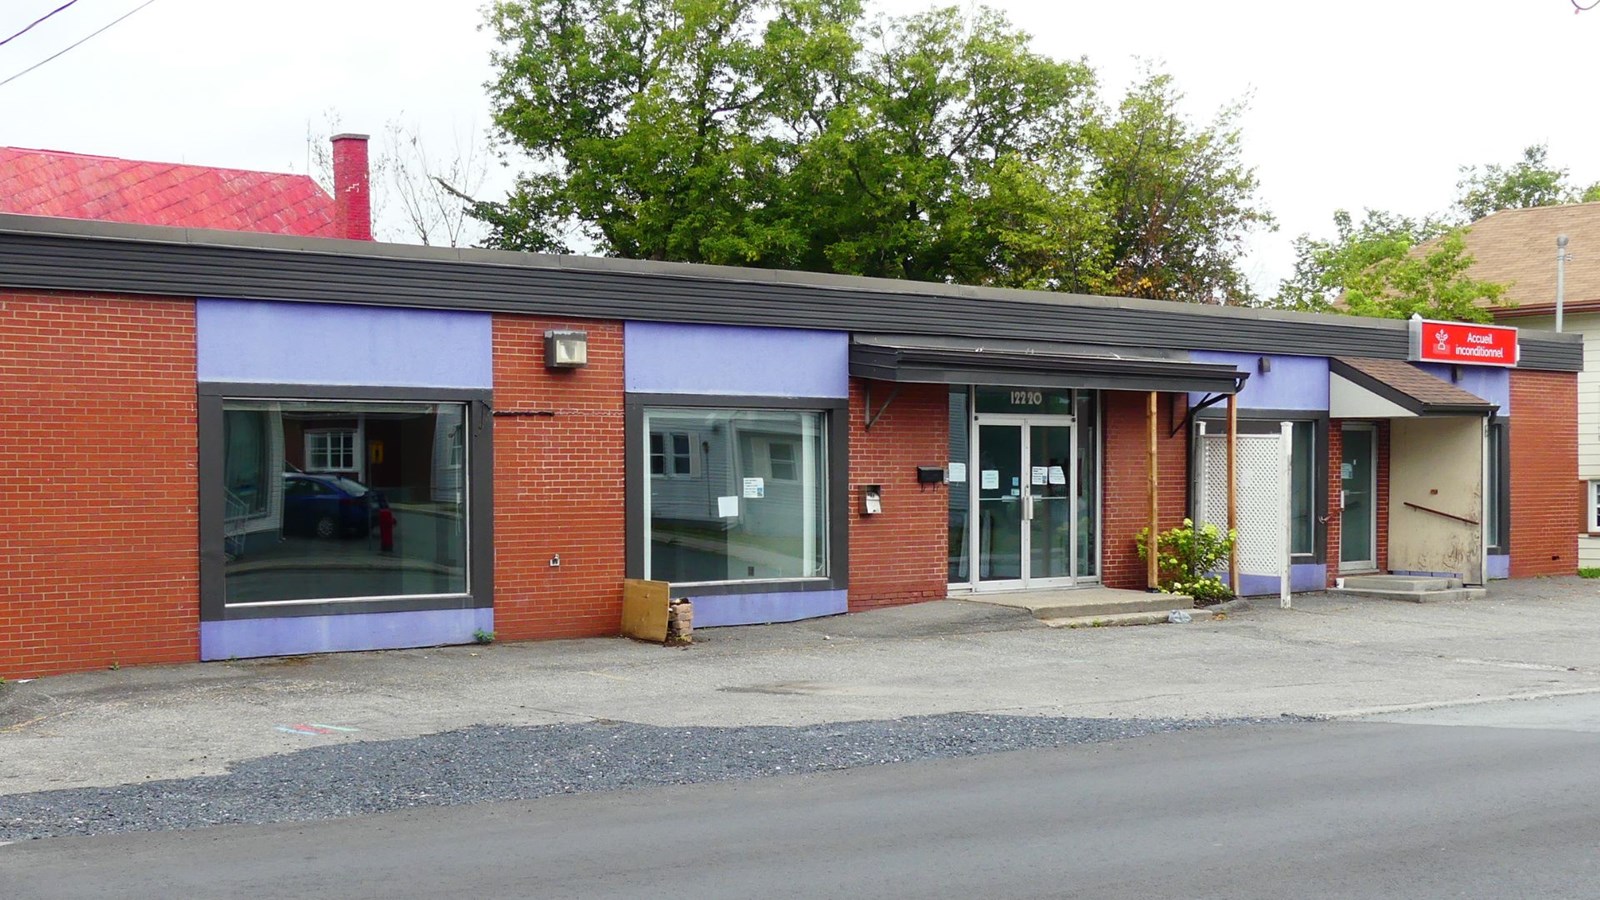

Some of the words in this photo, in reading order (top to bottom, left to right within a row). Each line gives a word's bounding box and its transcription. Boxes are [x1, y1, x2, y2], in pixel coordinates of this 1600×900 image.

[1467, 332, 1493, 344] Accueil
[1455, 344, 1504, 358] inconditionnel
[1010, 391, 1042, 405] 12220
